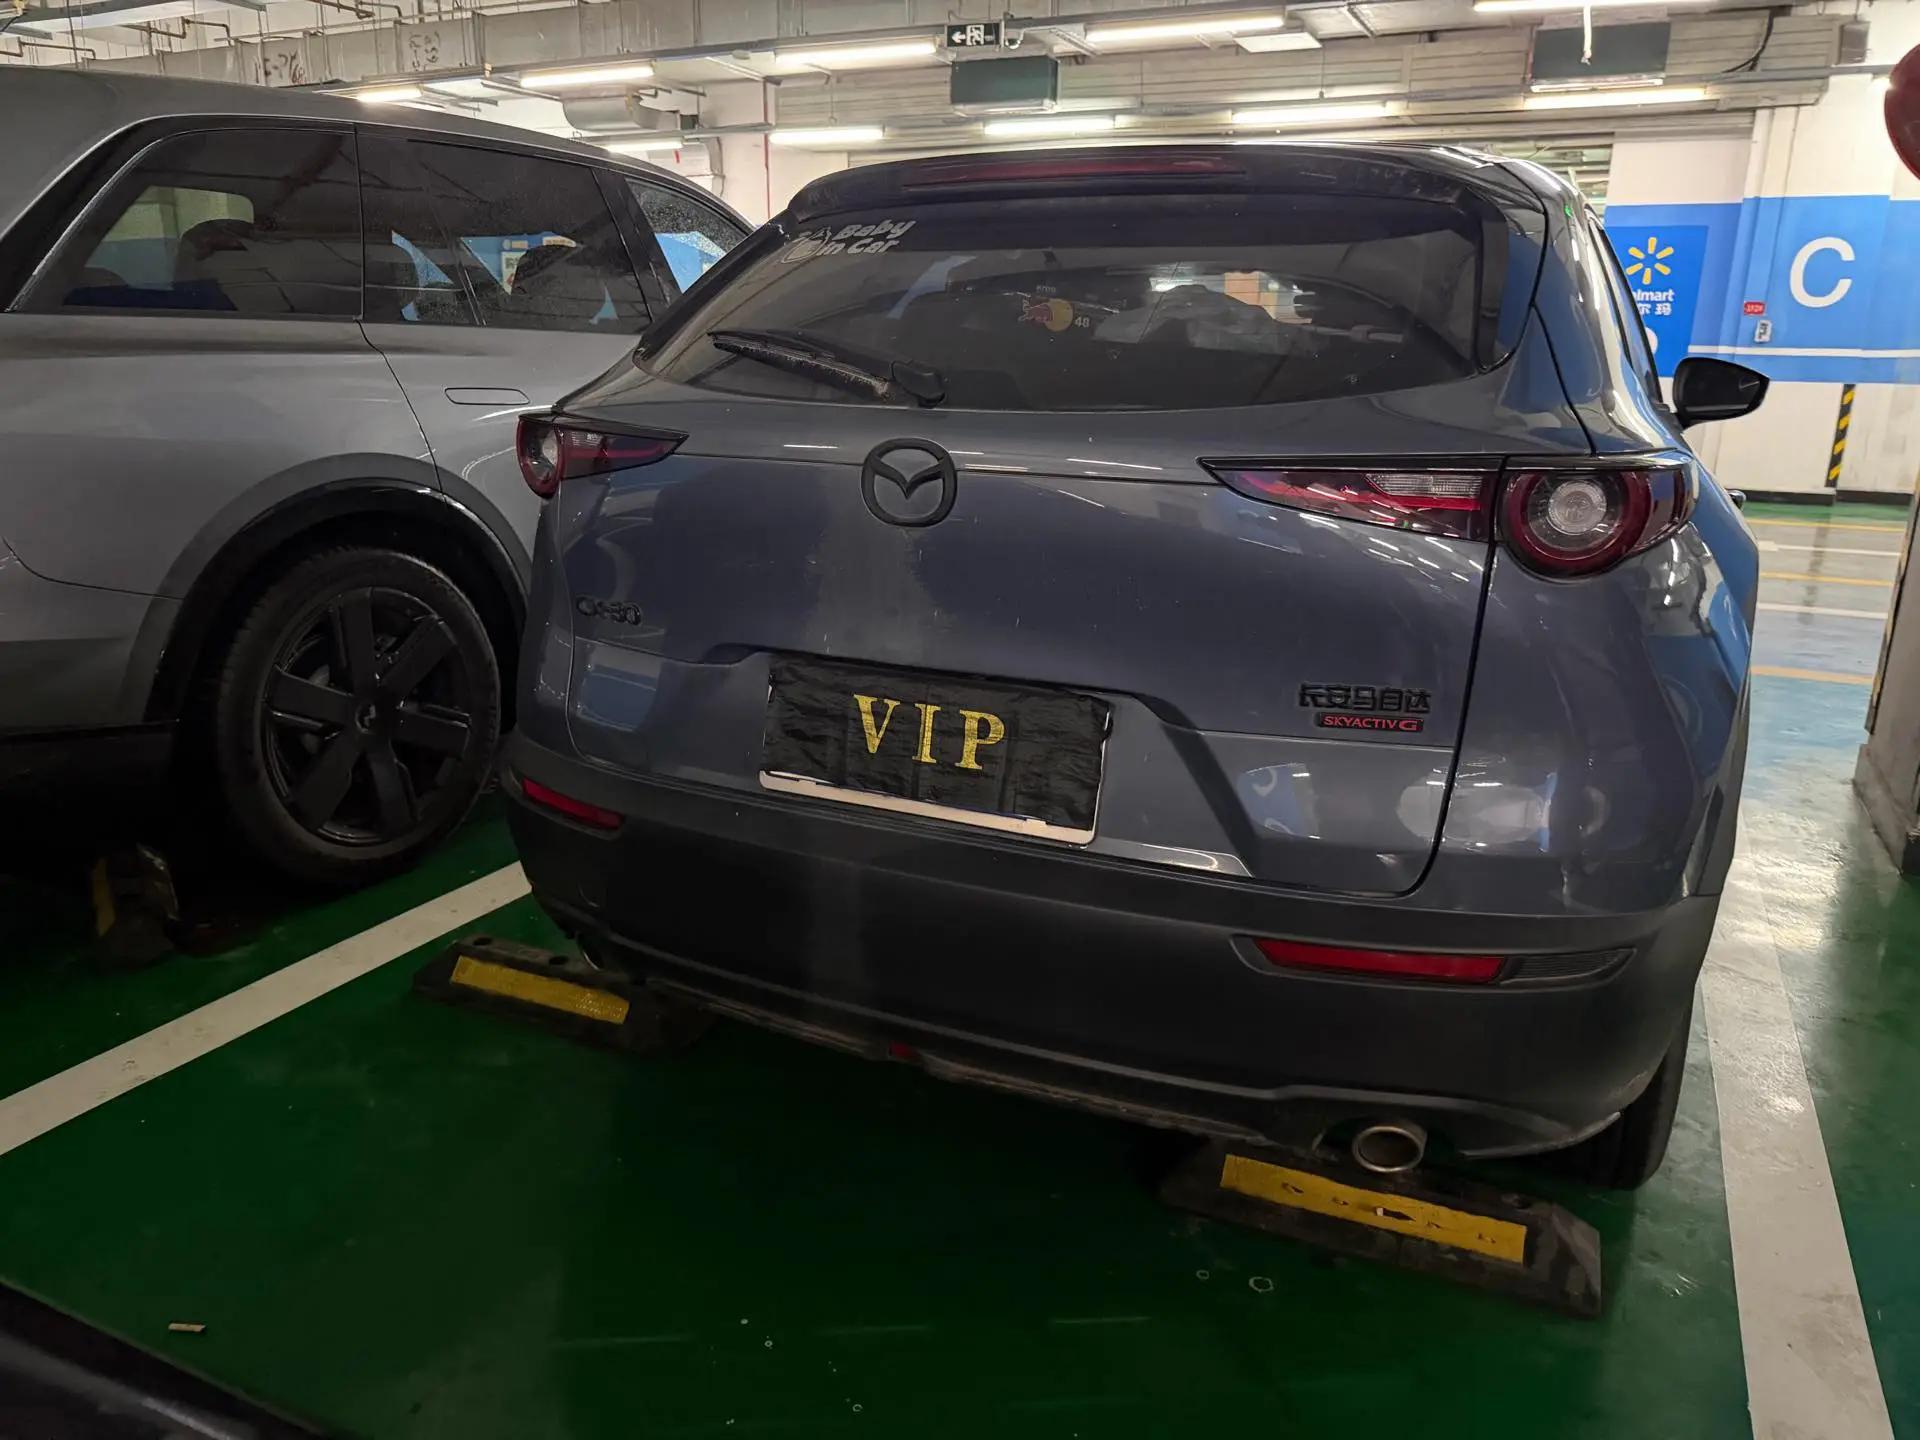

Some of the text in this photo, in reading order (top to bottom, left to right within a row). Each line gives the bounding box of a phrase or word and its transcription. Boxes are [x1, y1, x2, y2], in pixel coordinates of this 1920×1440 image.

[833, 219, 916, 240] Baby
[847, 238, 899, 254] Car
[1789, 235, 1855, 308] C
[1638, 303, 1671, 315] 尔玛
[1299, 683, 1432, 714] 长安马自达
[853, 694, 1005, 770] VIP
